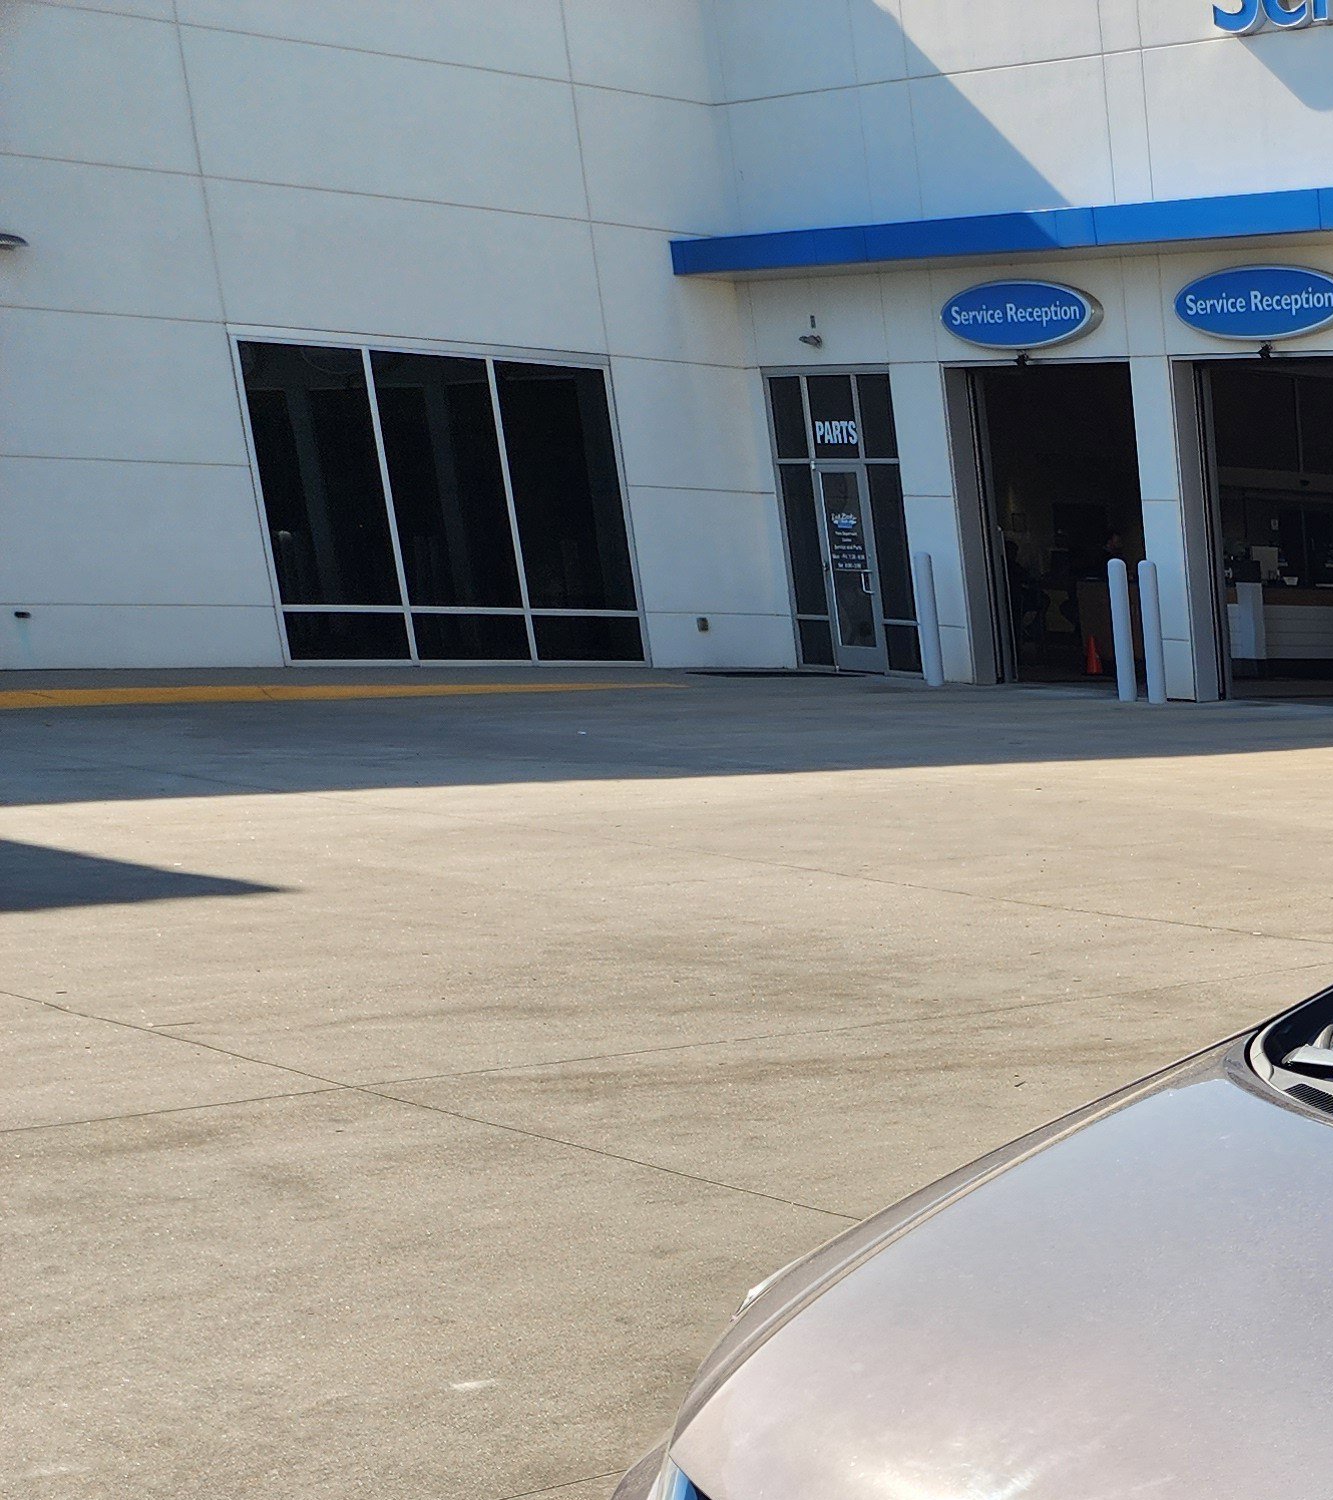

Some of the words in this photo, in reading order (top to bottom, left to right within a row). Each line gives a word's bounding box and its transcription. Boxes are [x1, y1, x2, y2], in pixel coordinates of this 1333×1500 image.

[950, 304, 1004, 326] Service
[1005, 300, 1080, 328] Reception
[1185, 292, 1247, 316] Service
[814, 420, 858, 445] PARTS
